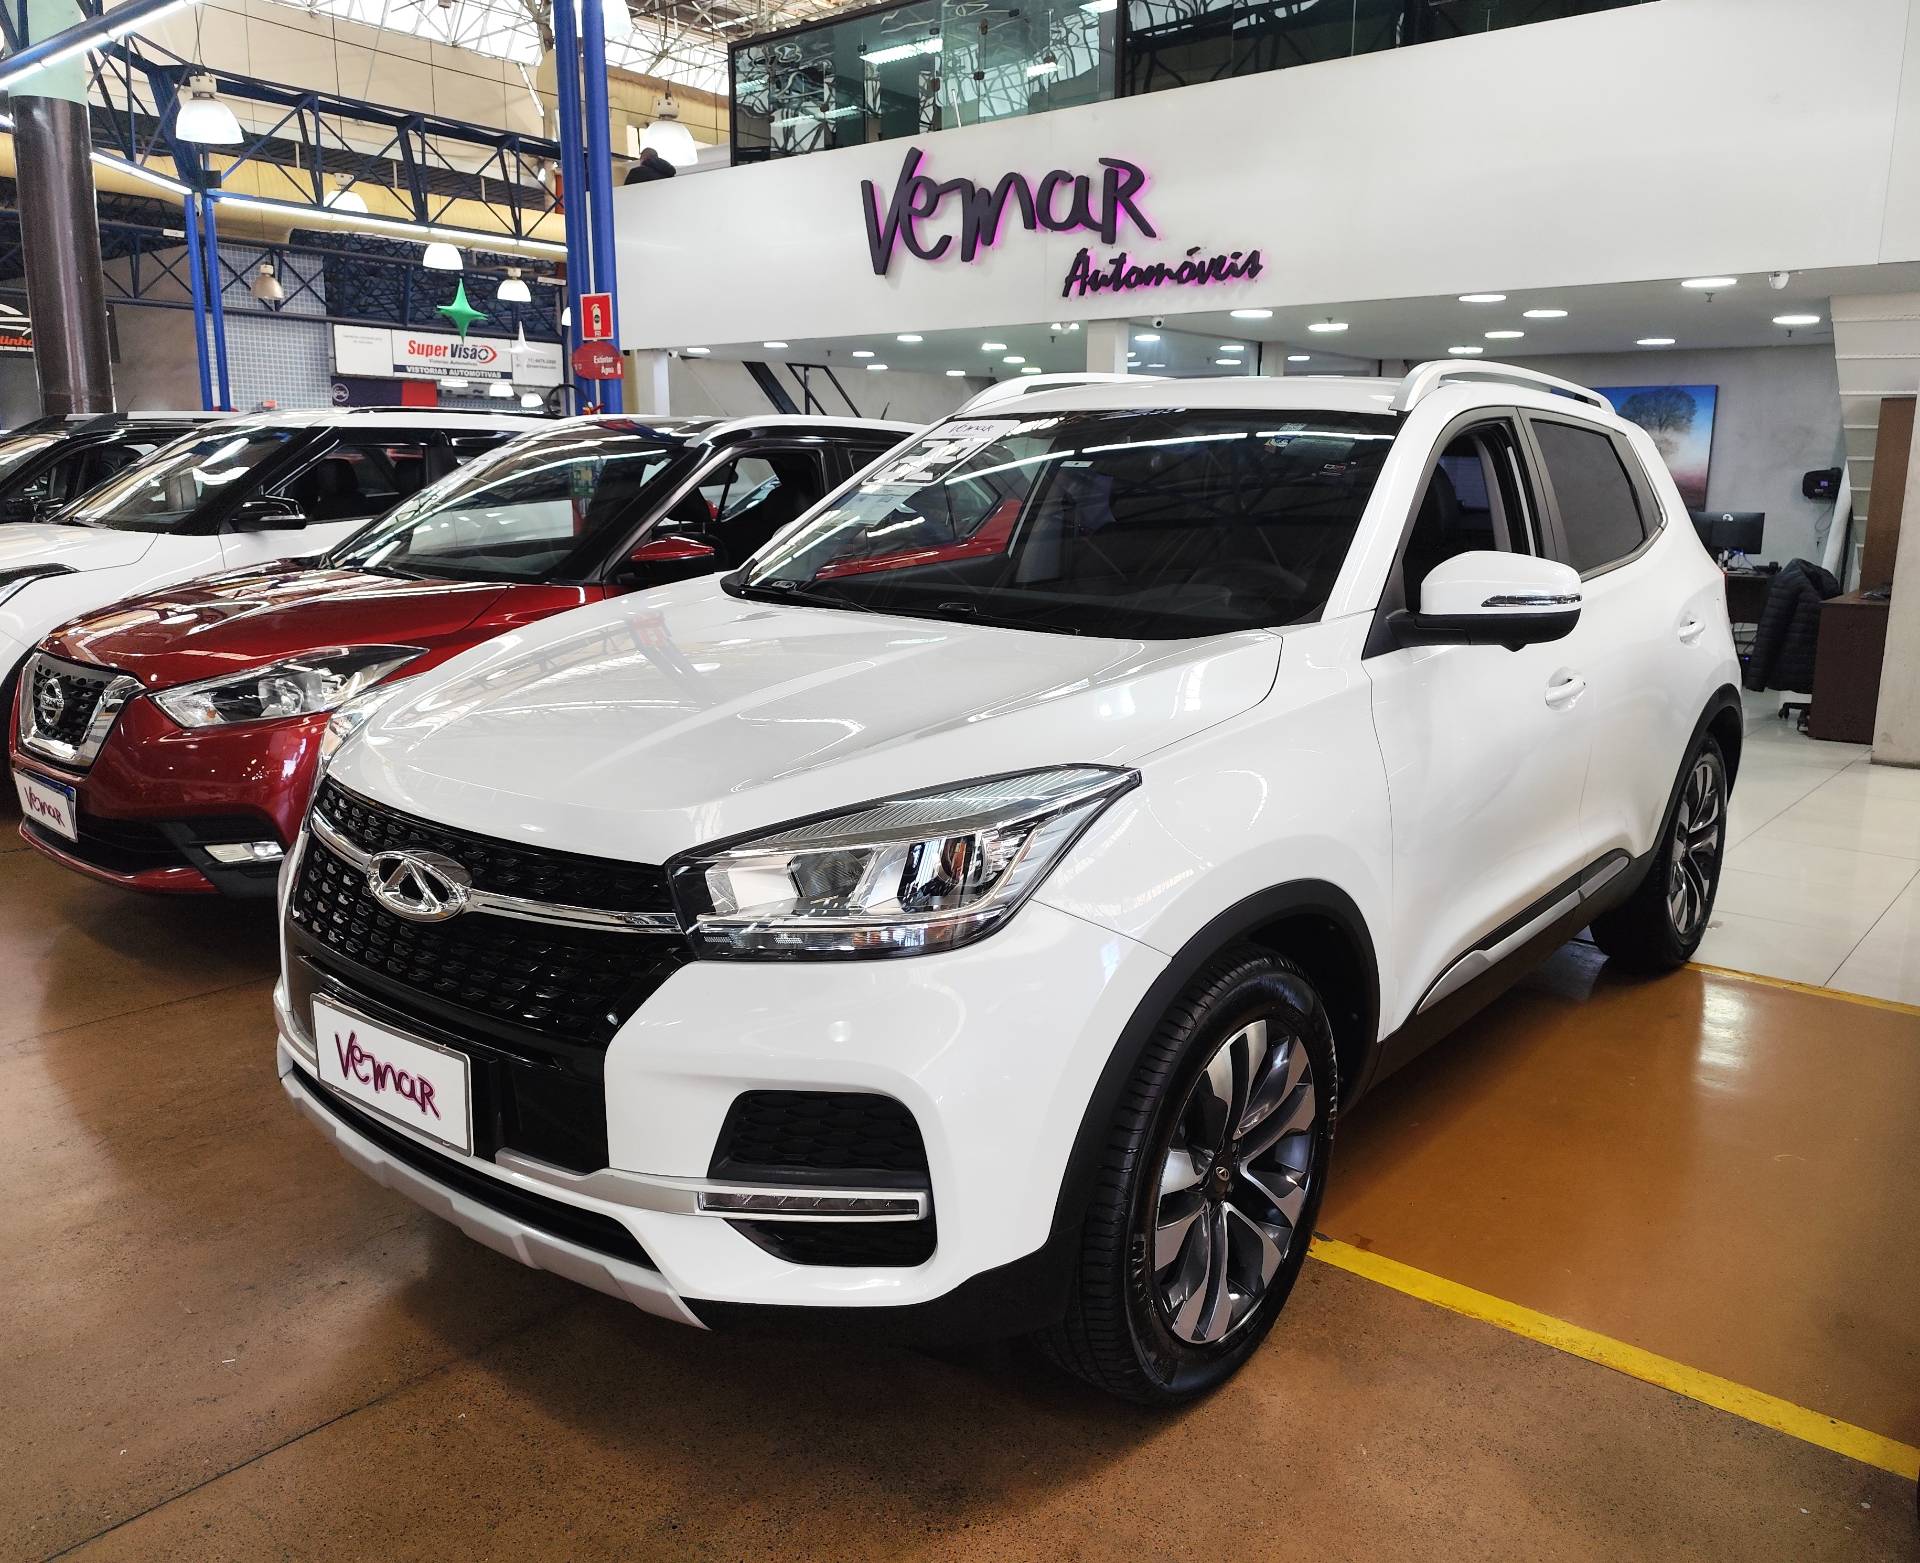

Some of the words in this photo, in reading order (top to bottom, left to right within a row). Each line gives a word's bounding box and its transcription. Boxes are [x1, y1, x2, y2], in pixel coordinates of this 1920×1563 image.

[1062, 247, 1263, 298] Automóveis
[408, 340, 448, 358] Super
[450, 343, 490, 361] Visão
[406, 366, 448, 377] VISTORIAS
[448, 368, 502, 379] AUTOMOTIVAS
